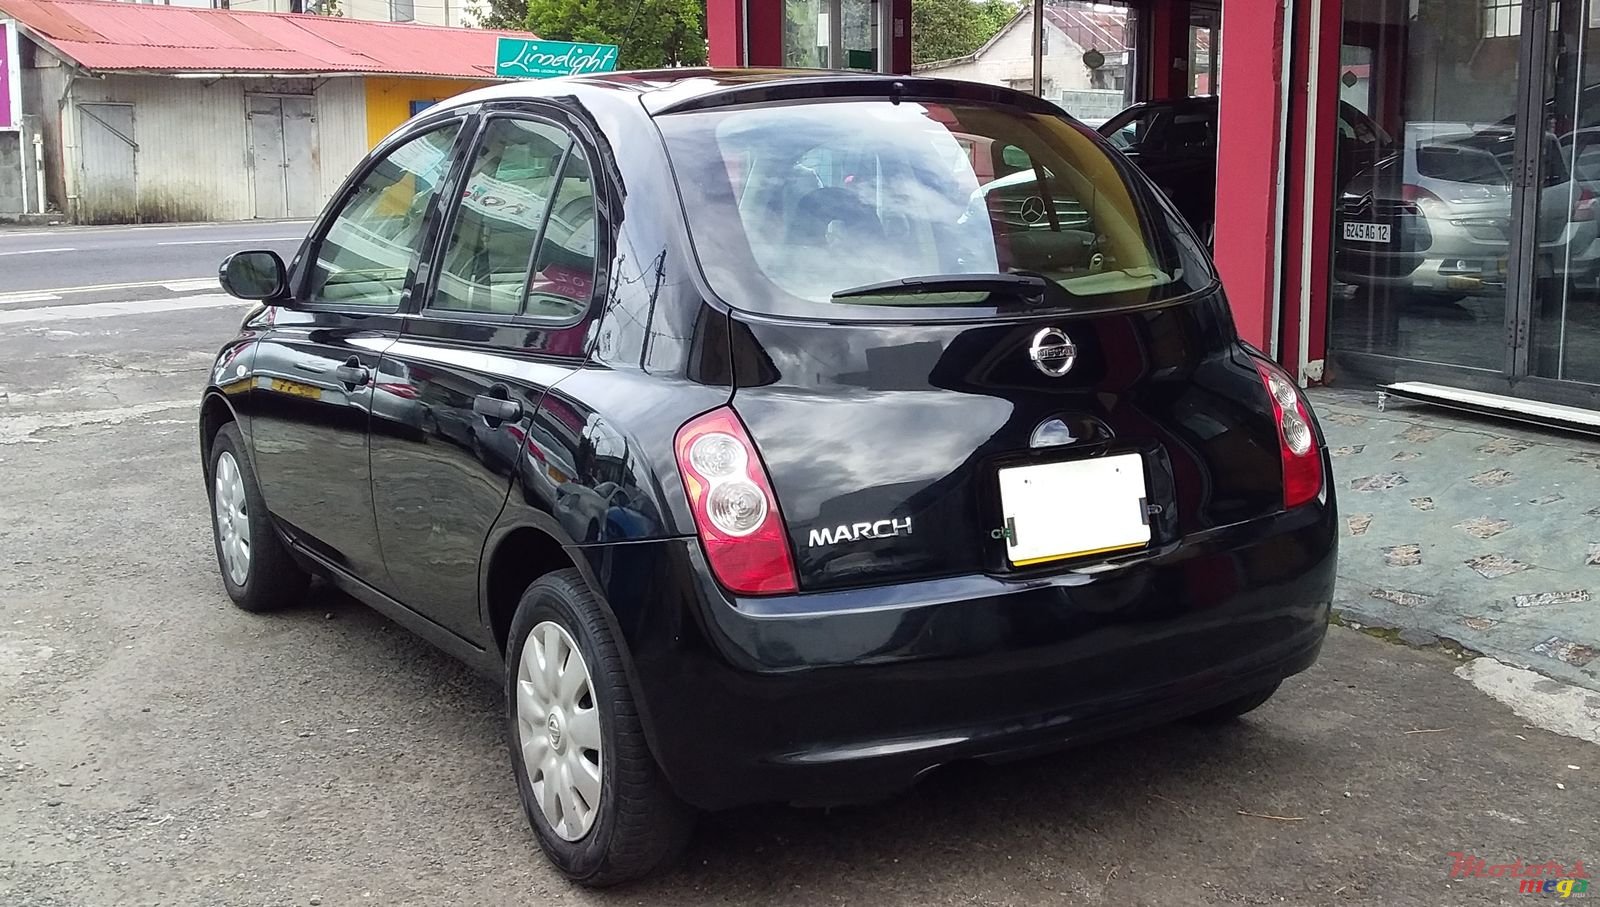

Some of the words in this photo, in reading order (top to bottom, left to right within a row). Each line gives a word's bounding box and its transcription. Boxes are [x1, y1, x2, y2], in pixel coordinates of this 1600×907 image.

[500, 41, 615, 76] Limelight
[1346, 224, 1363, 239] 6245
[1365, 225, 1375, 239] AG
[1378, 226, 1387, 240] 12
[808, 517, 912, 547] MARCH
